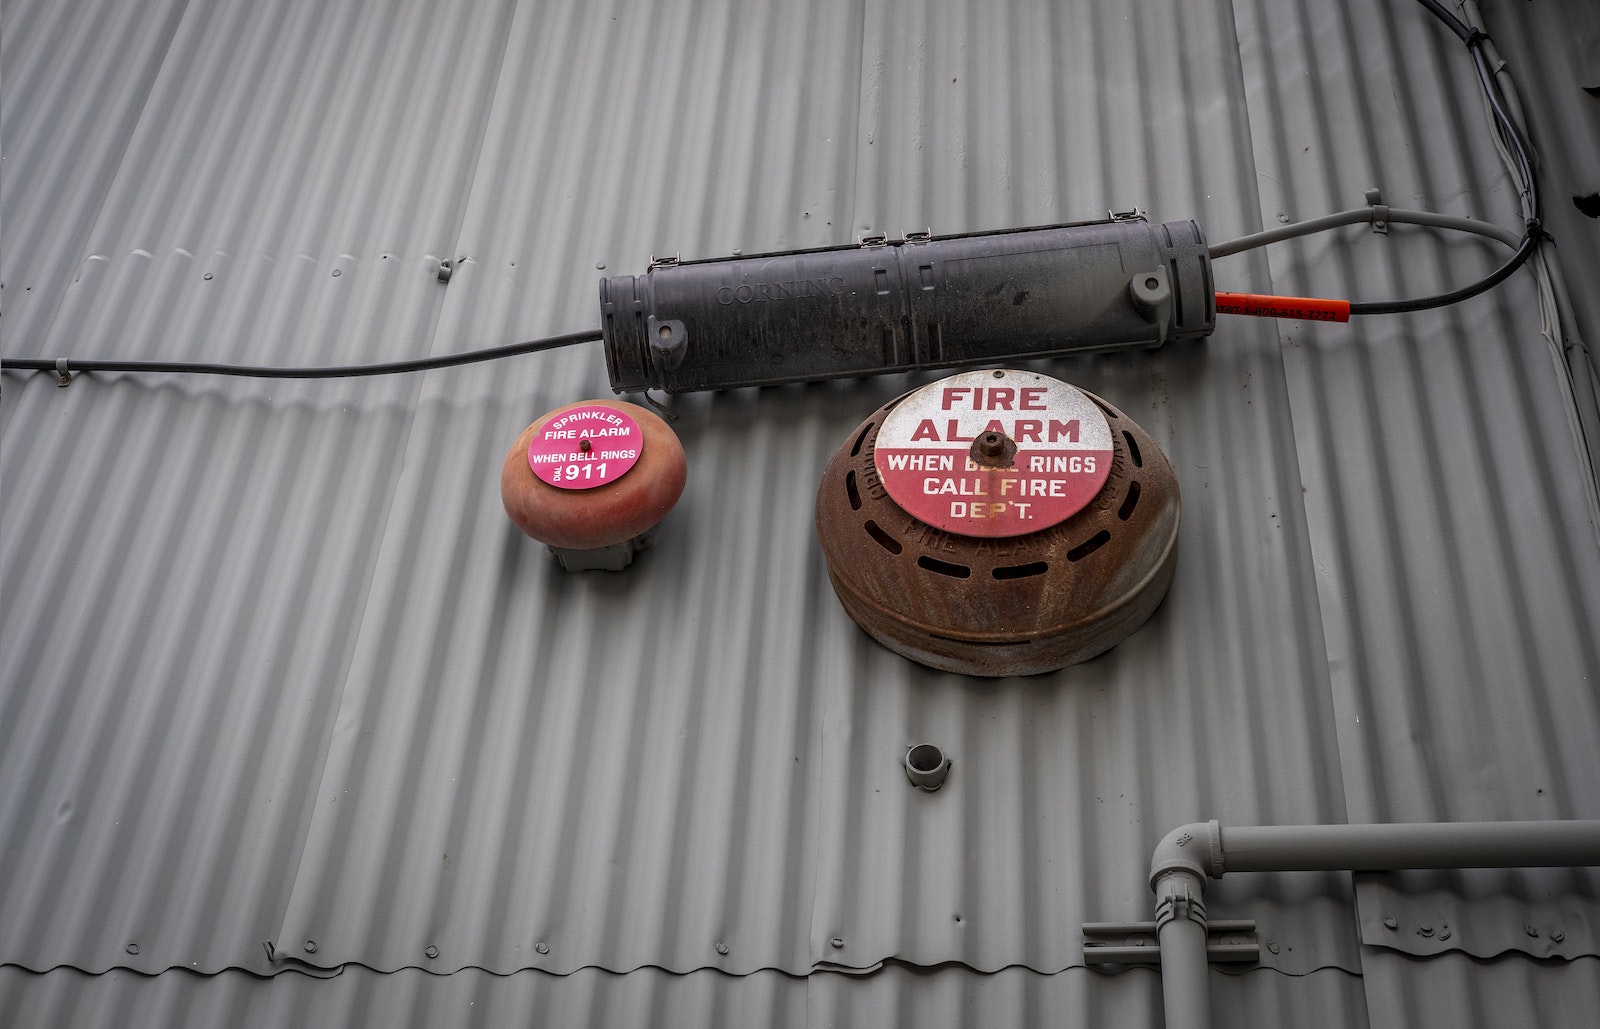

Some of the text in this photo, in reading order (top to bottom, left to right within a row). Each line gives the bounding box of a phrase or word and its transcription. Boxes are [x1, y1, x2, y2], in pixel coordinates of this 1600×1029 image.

[717, 275, 848, 306] CORNING
[941, 387, 1048, 411] FIRE
[552, 411, 624, 430] SPRINKLER
[544, 426, 630, 441] FIRE ALARM
[533, 449, 636, 464] WHEN BELL RINGS
[887, 454, 954, 471] WHEN
[1029, 455, 1096, 474] RINGS
[552, 462, 607, 482] DIAL 911
[923, 477, 1067, 497] CALL FIRE
[950, 500, 1033, 519] DEP'T.
